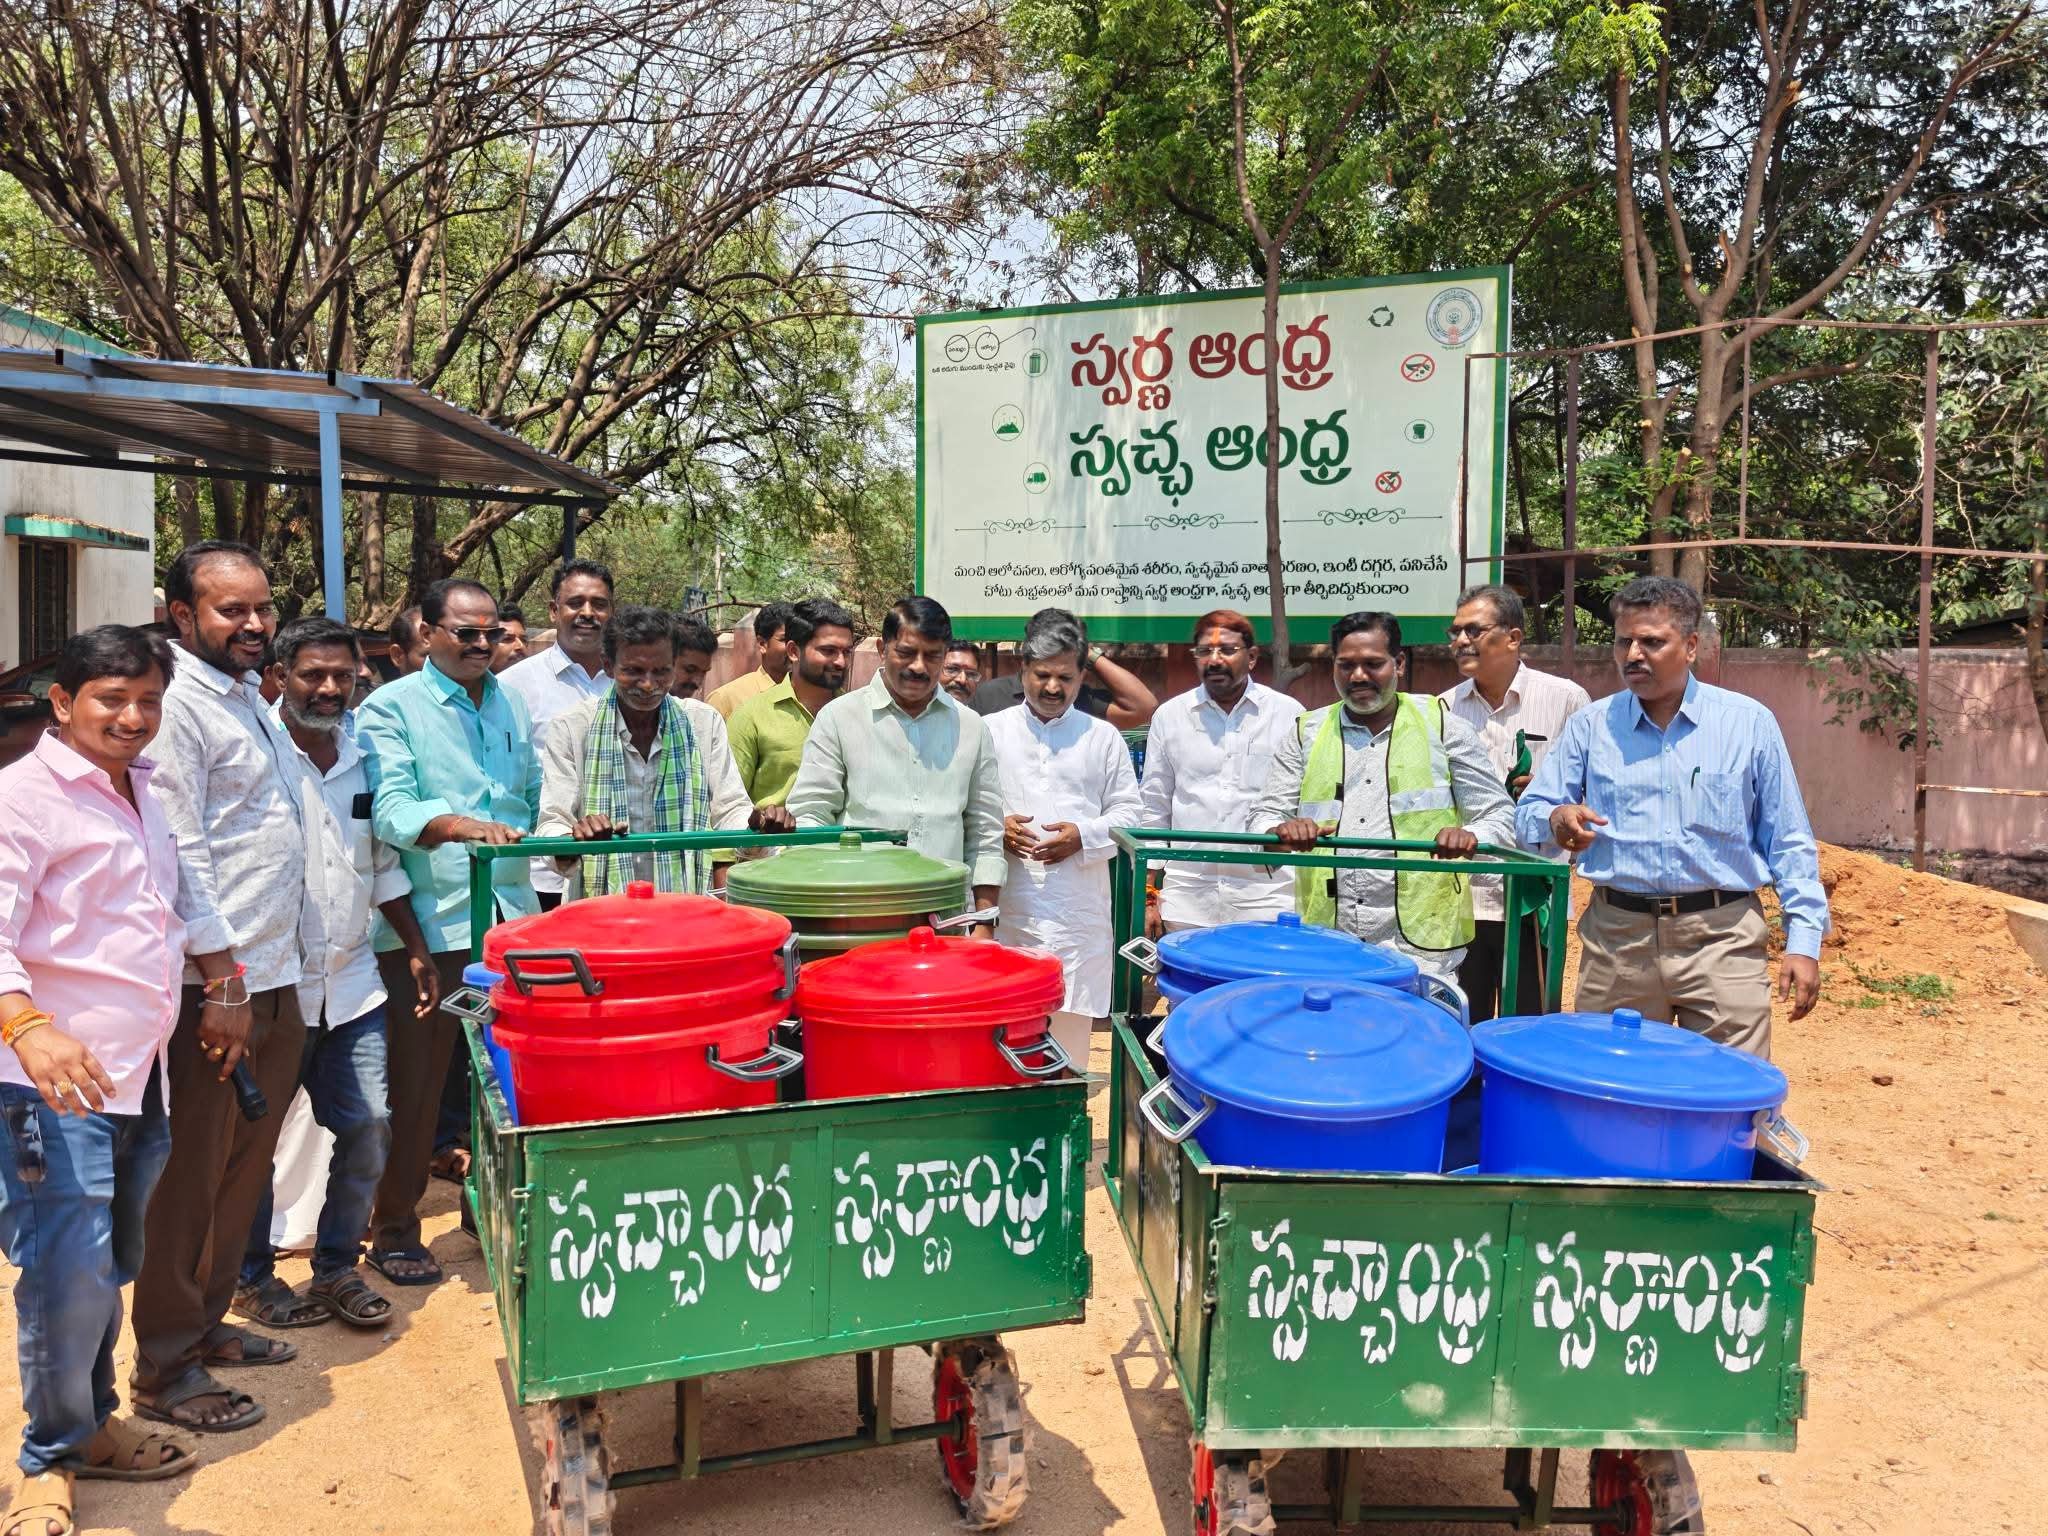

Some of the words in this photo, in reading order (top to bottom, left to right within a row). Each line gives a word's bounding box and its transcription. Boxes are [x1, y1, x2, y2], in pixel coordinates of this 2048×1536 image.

[1070, 327, 1174, 411] స్వర్ణ
[1188, 314, 1334, 391] ఆంధ్ర
[1069, 419, 1194, 508] స్వచ్ఛ
[1205, 409, 1353, 486] ఆంధ్ర
[954, 565, 986, 577] మంచి
[1049, 561, 1139, 581] ఆరోగ్యవంతమైన
[1141, 561, 1182, 576] శరీరం,
[1322, 557, 1358, 573] ఇంటి
[1360, 558, 1397, 578] దగ్గర,
[1399, 555, 1448, 572] పనిచేసే
[984, 584, 1013, 597] చోటు
[1014, 583, 1073, 600] శుభ్రతలతో
[1074, 585, 1099, 597] మన
[1303, 579, 1410, 601] తీర్చిదిద్దుకుందాం
